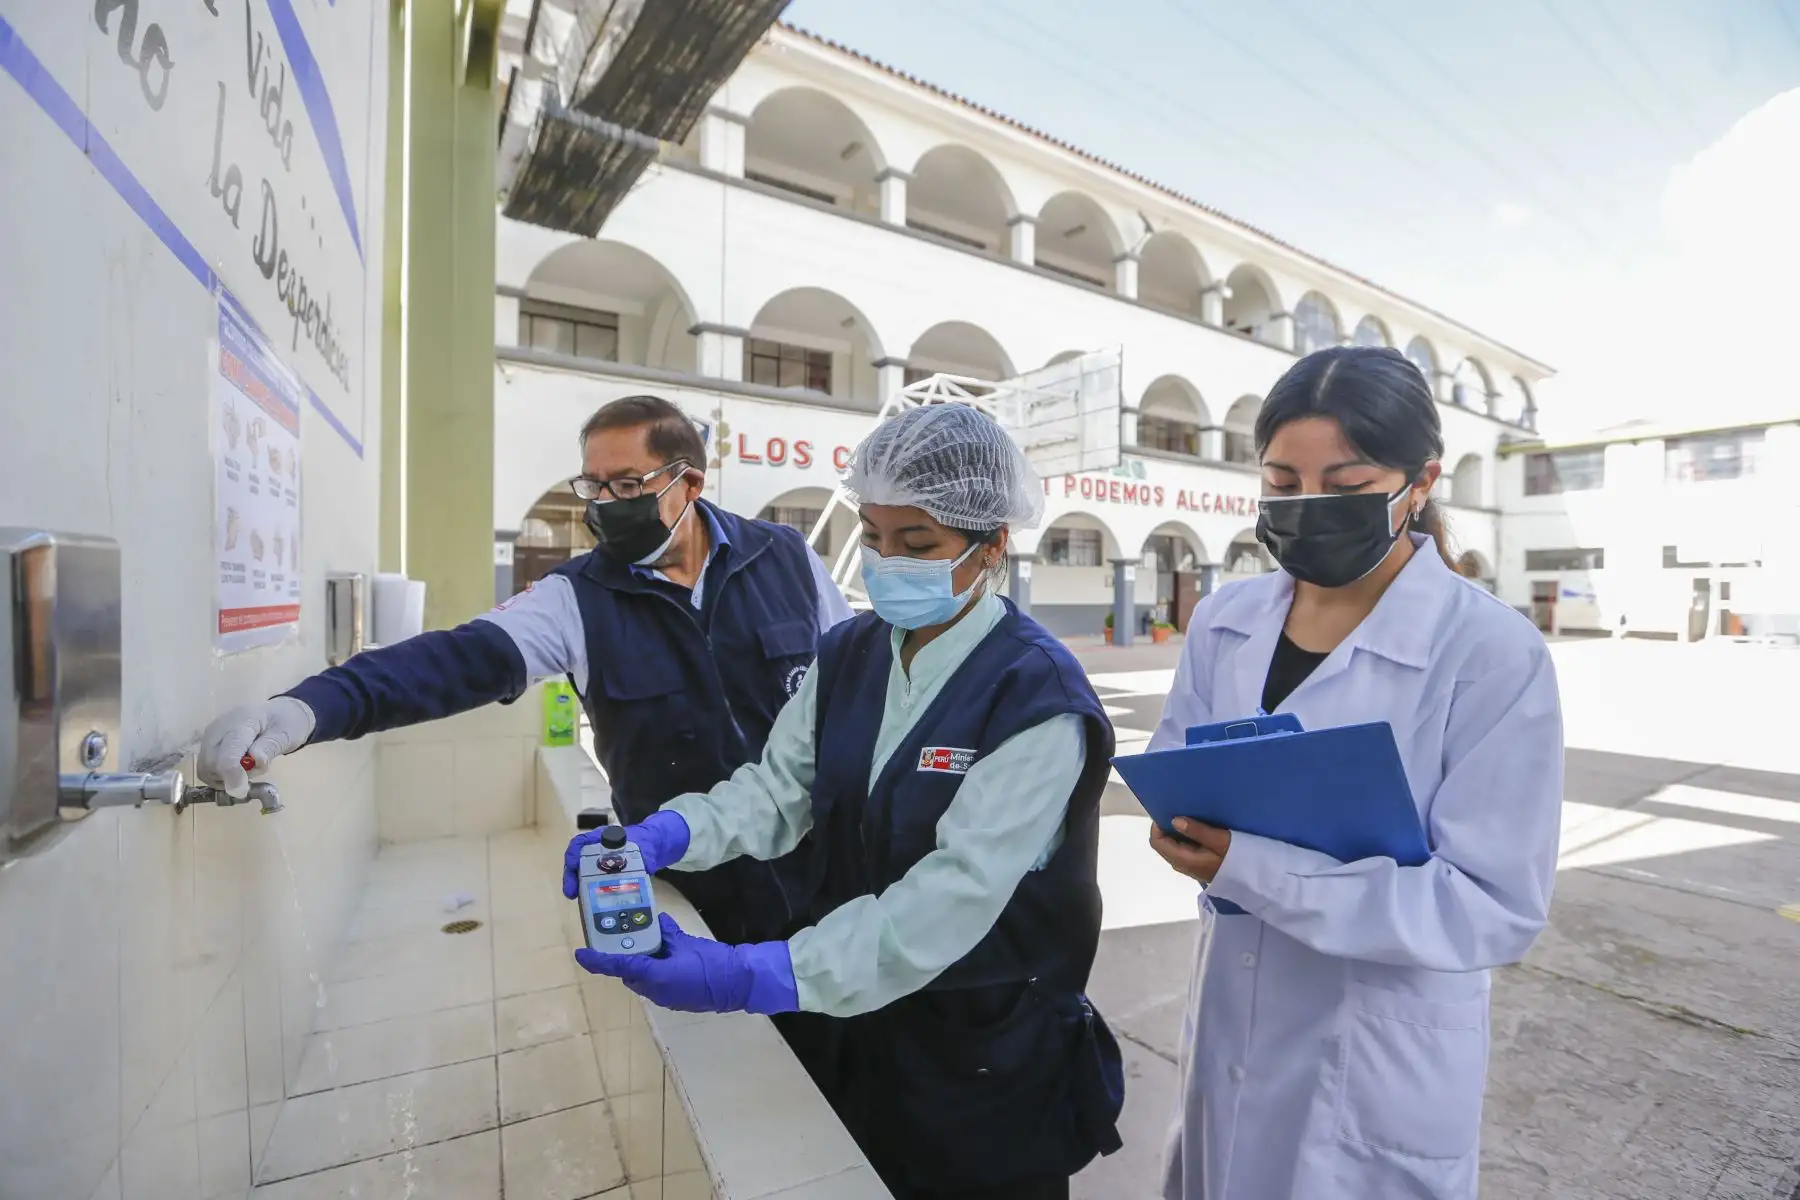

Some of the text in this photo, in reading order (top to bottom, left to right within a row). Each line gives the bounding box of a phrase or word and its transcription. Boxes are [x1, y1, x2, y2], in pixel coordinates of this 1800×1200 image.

[245, 0, 294, 173] Vida
[738, 431, 813, 470] LOS
[1063, 473, 1166, 507] PODEMOS
[1176, 489, 1258, 517] ALCANZA
